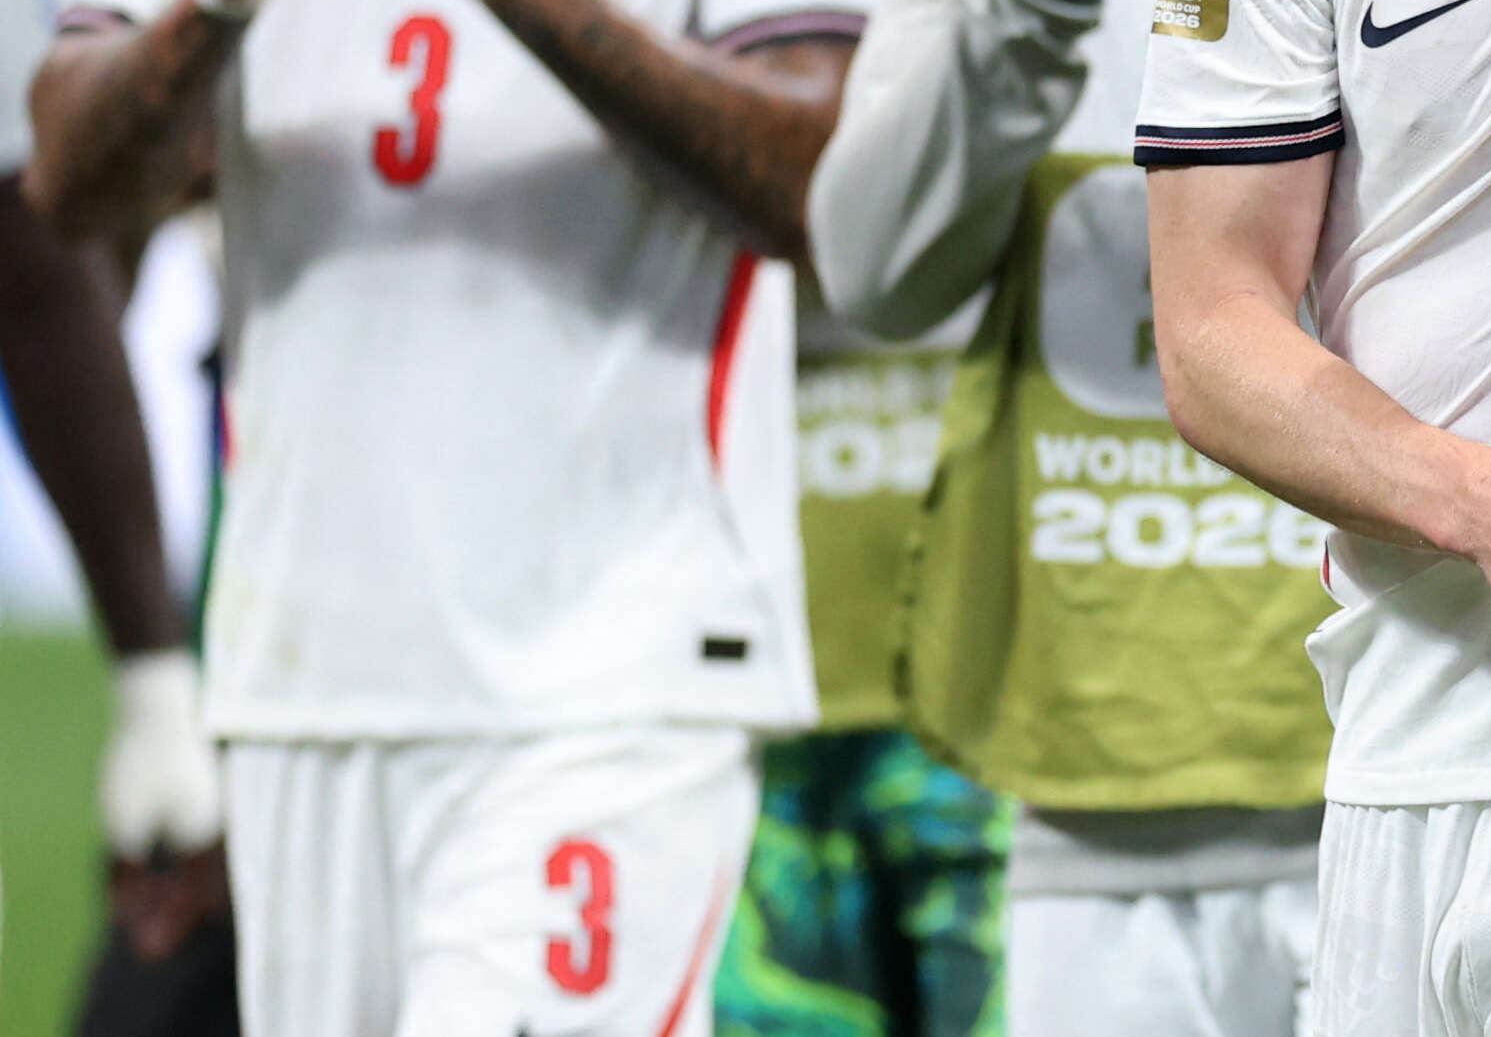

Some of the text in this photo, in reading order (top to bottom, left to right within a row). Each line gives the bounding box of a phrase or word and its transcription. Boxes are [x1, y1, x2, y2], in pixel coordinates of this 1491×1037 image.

[1153, 10, 1201, 29] 2026
[1157, 0, 1201, 14] ORLD CUP
[369, 13, 456, 187] 3
[1032, 488, 1327, 570] 2026
[543, 836, 616, 996] 3
